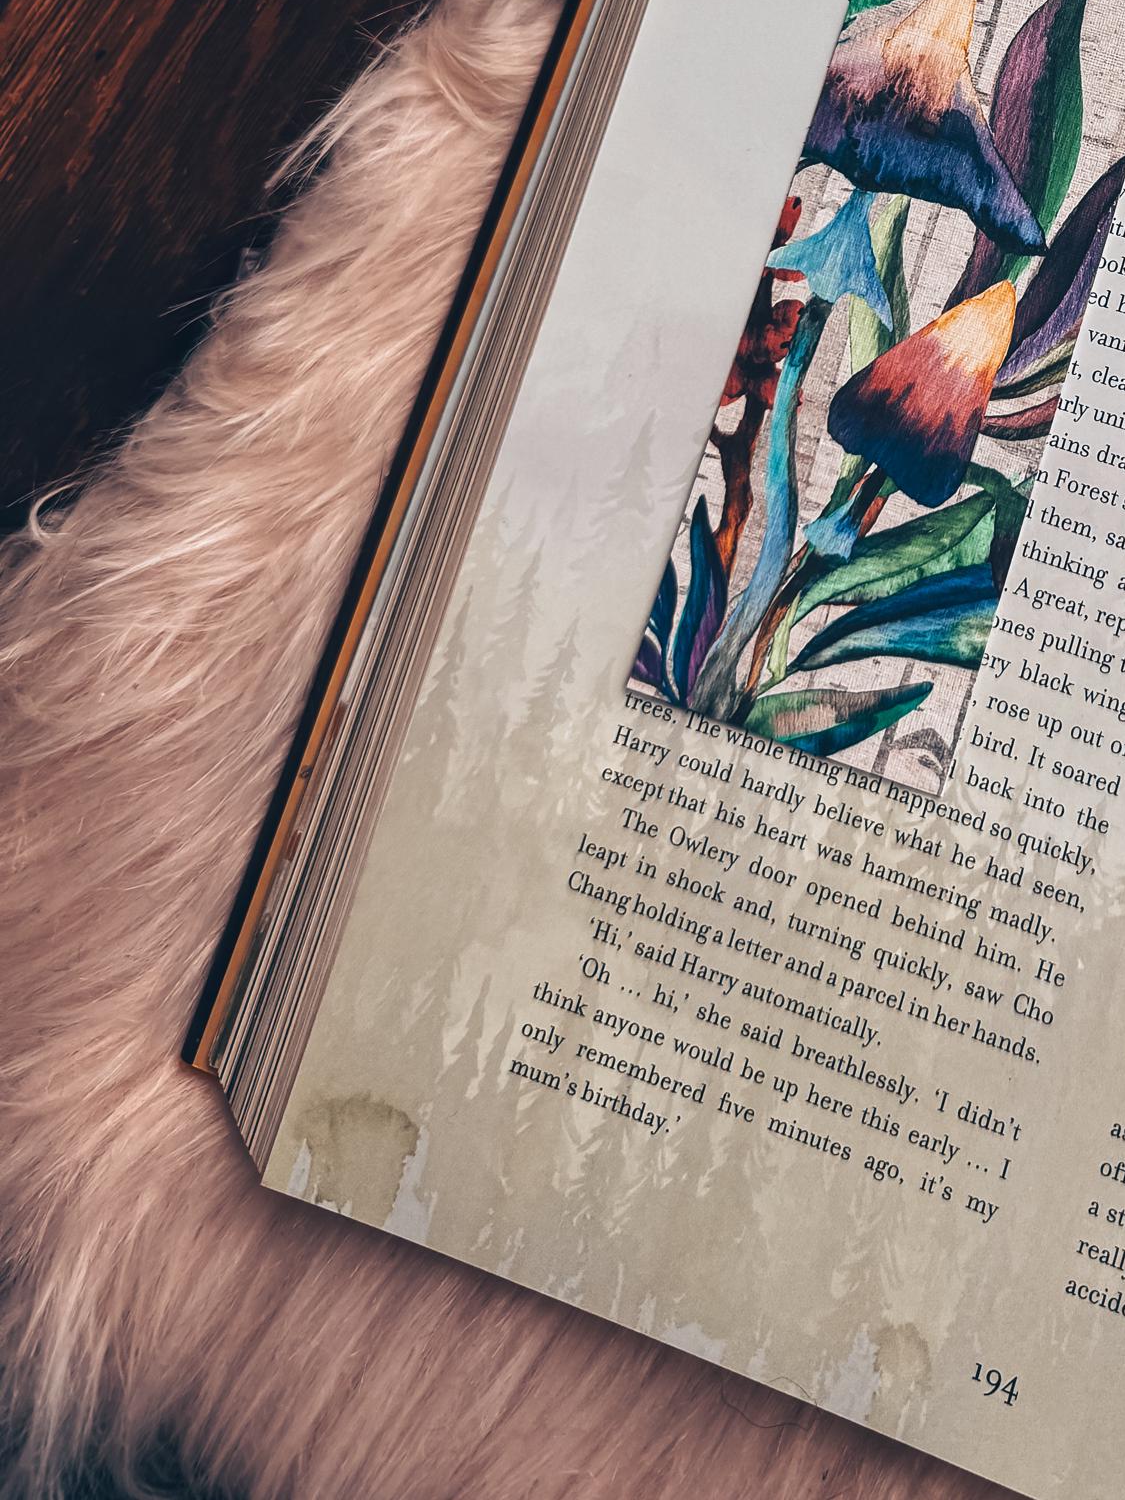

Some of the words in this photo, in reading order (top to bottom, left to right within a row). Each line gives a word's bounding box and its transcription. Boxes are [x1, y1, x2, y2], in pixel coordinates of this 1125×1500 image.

[1011, 576, 1031, 600] A
[1030, 588, 1089, 623] great,
[1021, 538, 1110, 591] thinking
[985, 694, 1031, 723] rose
[1036, 712, 1064, 740] up
[1069, 724, 1106, 749] out
[969, 723, 1019, 762] bird.
[1027, 744, 1047, 770] It
[1050, 760, 1122, 798] soared
[611, 723, 672, 768] Harry
[677, 753, 735, 785] could
[739, 767, 807, 815] hardly
[812, 793, 886, 838] believe
[893, 827, 943, 859] what
[949, 841, 977, 871] he
[983, 854, 1025, 889] had
[1031, 879, 1086, 915] seen,
[964, 764, 1016, 802] back
[1022, 791, 1066, 819] into
[1076, 806, 1110, 836] the
[600, 767, 666, 803] except
[666, 785, 707, 816] that
[713, 799, 747, 830] his
[752, 813, 808, 852] heart
[816, 842, 854, 868] was
[860, 851, 983, 921] hammering
[988, 905, 1056, 946] madly.
[576, 832, 628, 871] leapt
[634, 854, 658, 880] in
[665, 867, 727, 905] shock
[732, 895, 777, 927] and,
[787, 911, 868, 962] turning
[872, 946, 953, 992] quickly,
[963, 980, 1005, 1007] saw
[1012, 992, 1055, 1026] Cho
[621, 806, 660, 840] The
[668, 825, 741, 873] Owlery
[747, 854, 799, 888] door
[805, 880, 884, 921] opened
[889, 903, 967, 952] behind
[973, 934, 1022, 974] him.
[1033, 956, 1066, 989] He
[520, 1022, 567, 1056] only
[574, 1042, 708, 1105] remembered
[716, 1091, 756, 1124] five
[766, 1116, 853, 1162] minutes
[862, 1154, 905, 1186] ago,
[964, 1194, 1000, 1225] my
[970, 1361, 1020, 1408] 194
